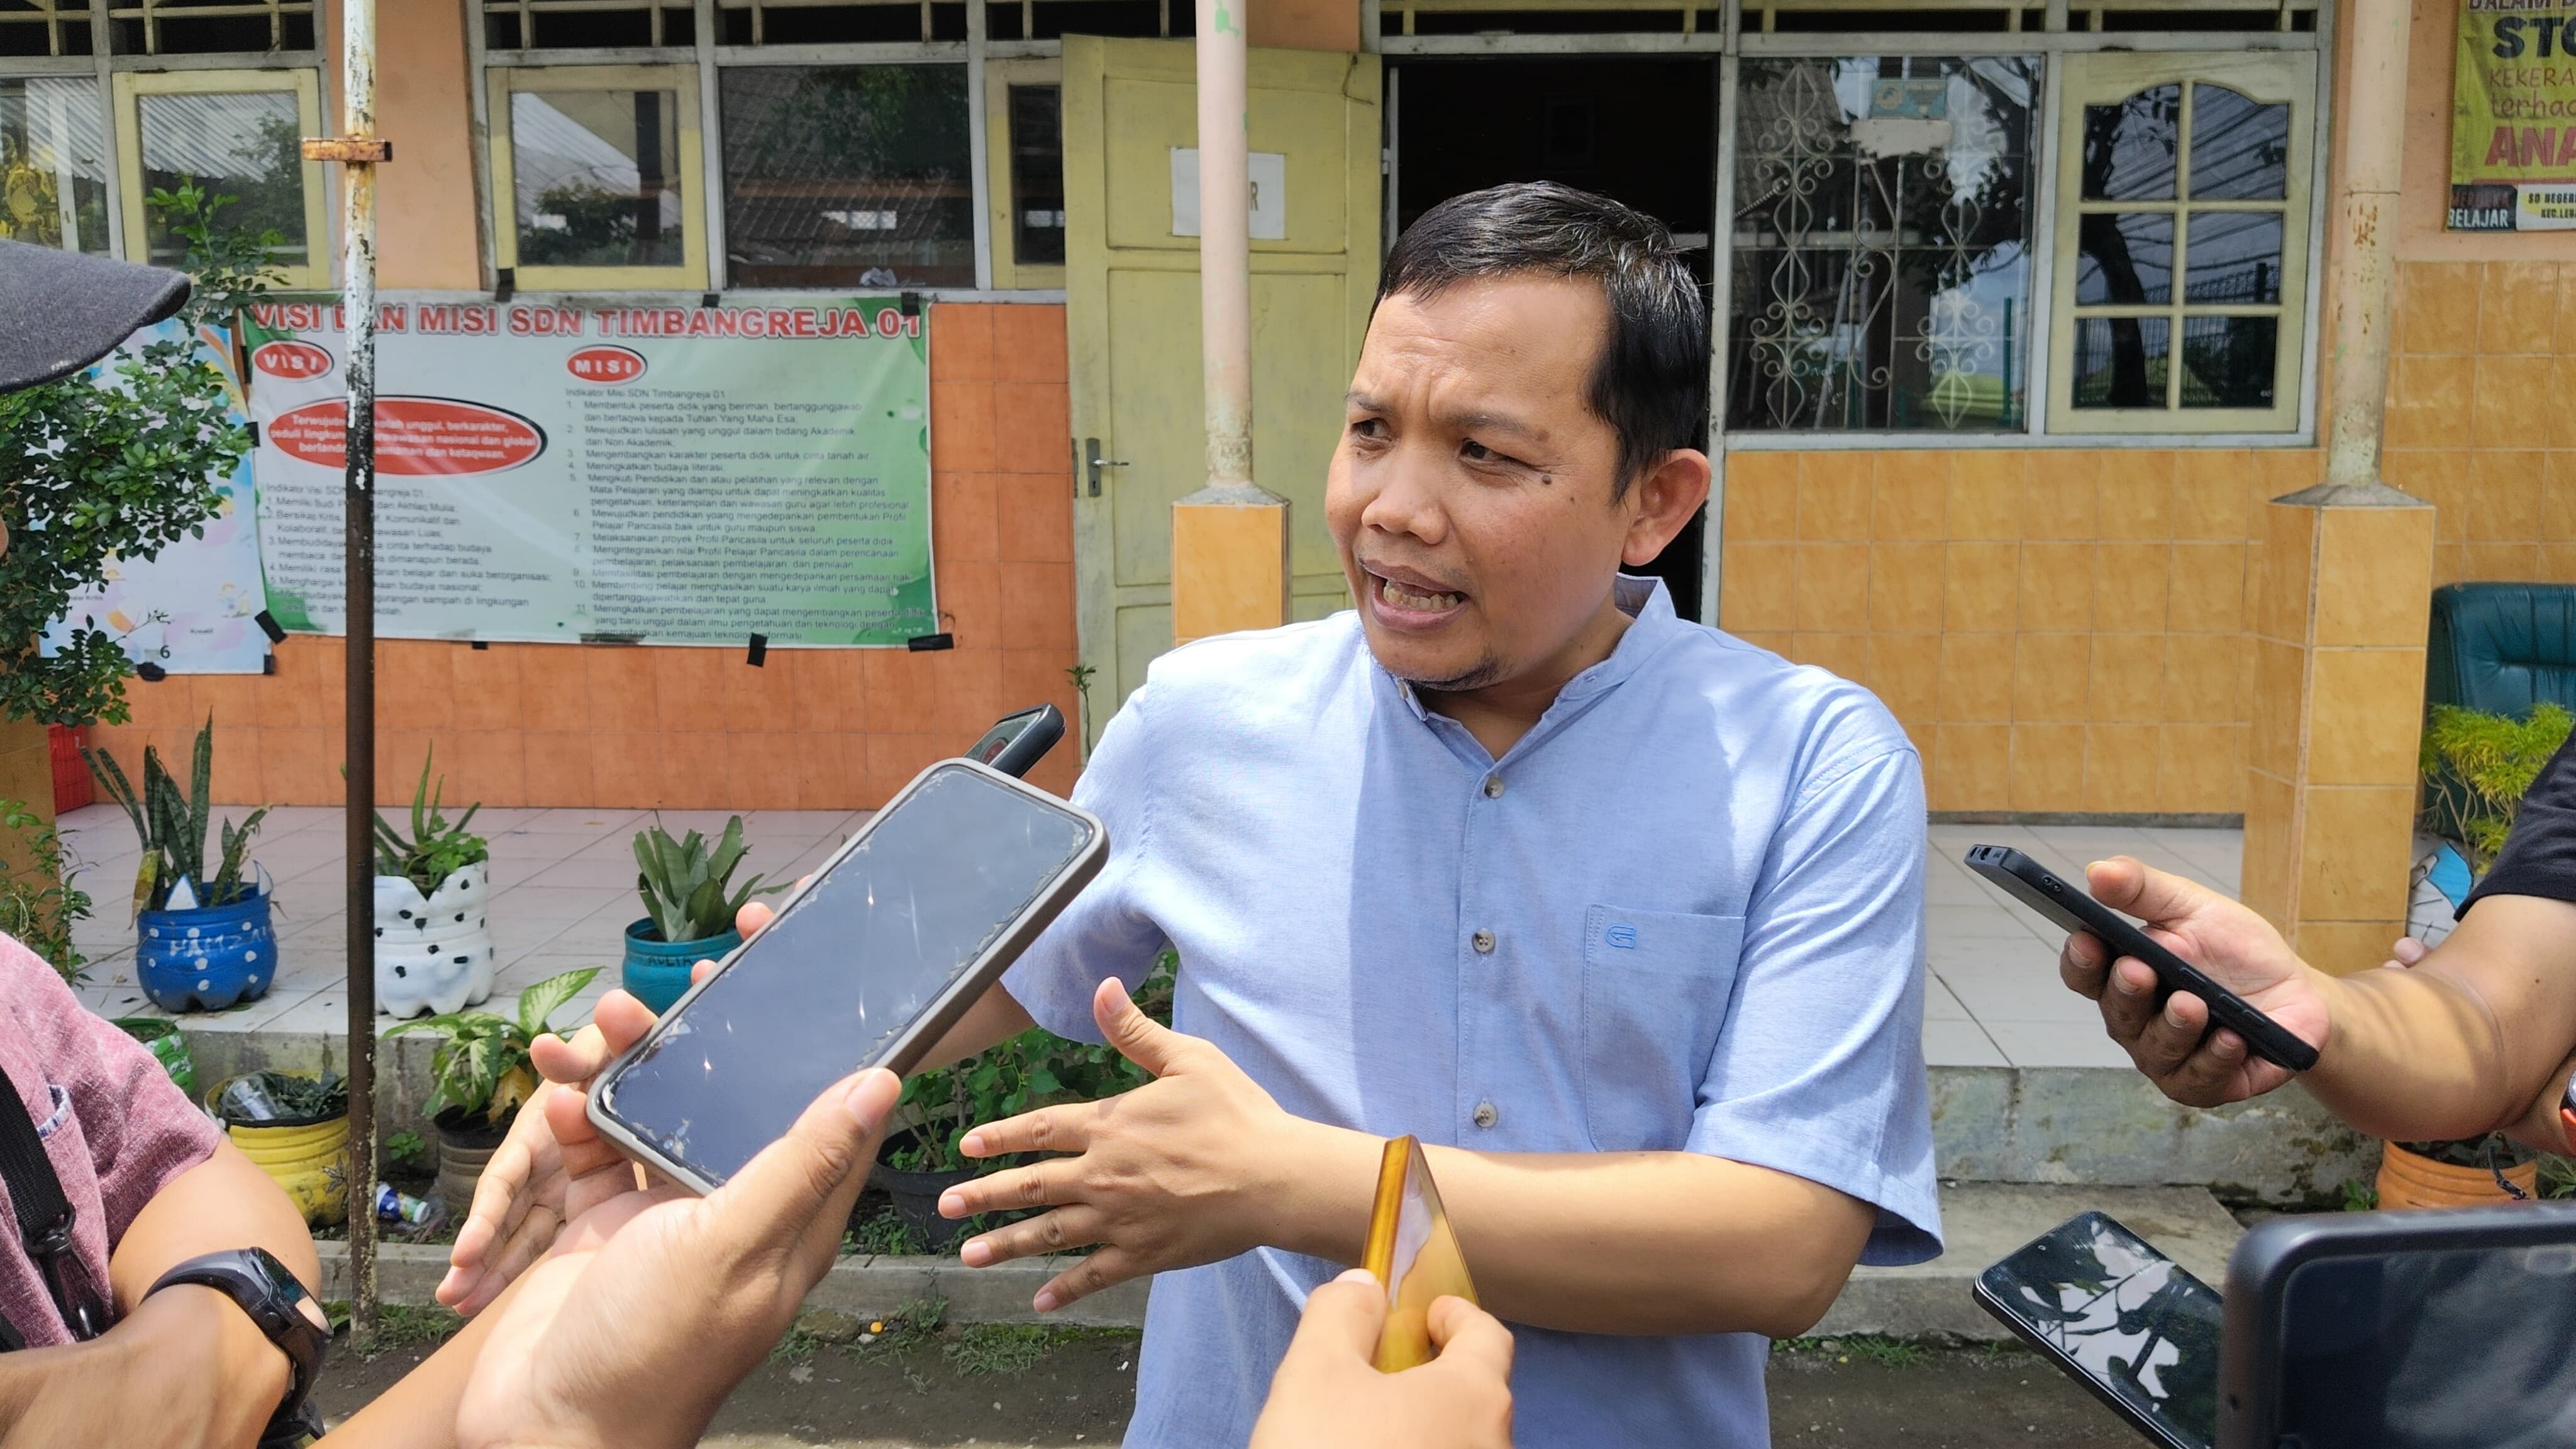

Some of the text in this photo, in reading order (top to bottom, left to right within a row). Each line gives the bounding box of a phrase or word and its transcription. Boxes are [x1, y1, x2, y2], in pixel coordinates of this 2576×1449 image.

[2490, 67, 2574, 87] KEKERA
[252, 303, 921, 338] VISI DN MISI SDN TIMBANGREJA 01
[264, 353, 317, 369] VISI
[575, 359, 632, 374] MISI
[608, 389, 625, 397] Misi
[628, 389, 649, 397] SDN
[653, 390, 709, 401] Timbangreja
[584, 401, 726, 412] Membentuk peserta didik yang
[584, 414, 774, 425] dan bertaqwa kepada Tuhan Yang Maha
[586, 426, 808, 438] Mewujudkan lulusan yang unggul dalam bidang
[586, 438, 624, 446] dan Non
[586, 449, 854, 461] Mengembangkan karakter peserta didik untuk tanah
[587, 462, 688, 473] Meningkatkan budaya
[636, 474, 688, 483] Pendidikan
[691, 475, 707, 483] dan
[711, 475, 731, 483] atau
[735, 475, 777, 486] pelatihan
[805, 475, 840, 484] relevan
[843, 476, 878, 487] dengan
[590, 486, 613, 494] Mata
[616, 486, 659, 496] Pelajaran
[663, 488, 685, 497] yang
[688, 486, 722, 497] diampu
[726, 487, 750, 495] untuk
[783, 487, 848, 498] meningkatkan
[851, 488, 886, 497] kualitas
[720, 499, 736, 507] dan
[786, 501, 806, 510] guru
[810, 502, 830, 510] agar
[592, 509, 879, 523] Mewujudkan pendidikan mengedepankan pembentukan
[592, 521, 623, 531] Pelajar
[628, 521, 672, 530] Pancasila
[697, 523, 721, 531] untuk
[724, 525, 745, 533] guru
[748, 525, 785, 534] maupun
[592, 533, 658, 543] Melaksanakan
[662, 535, 691, 545] proyek
[723, 535, 766, 544] Pancasila
[770, 536, 795, 544] untuk
[799, 536, 834, 545] seluruh
[837, 536, 869, 547] peserta
[724, 547, 757, 558] Pelajar
[761, 548, 806, 557] Pancasila
[809, 548, 837, 557] dalam
[840, 550, 898, 560] perencanaan
[662, 558, 810, 569] pelaksanaan dan
[440, 569, 457, 578] dan
[461, 570, 483, 579] suka
[657, 570, 892, 583] pembelajaran dengan mengedepankan persamaan
[657, 582, 687, 592] pelajar
[691, 582, 755, 593] menghasilkan
[758, 583, 782, 591] suatu
[786, 584, 811, 594] karya
[814, 584, 840, 592] ilmiah
[843, 586, 865, 595] yang
[868, 584, 894, 595] dapat
[697, 594, 765, 605] dan tepat guna
[594, 604, 862, 618] Meningkatkan pembelajaran yang dapat mengembangkan
[595, 618, 617, 627] yang
[619, 616, 640, 625] baru
[643, 617, 674, 628] unggul
[677, 618, 706, 626] dalam
[731, 618, 791, 629] pengetahuan
[795, 619, 811, 628] dan
[815, 619, 857, 630] teknologi
[860, 620, 894, 631] dengan
[667, 629, 711, 640] kemajuan
[160, 645, 170, 659] 6
